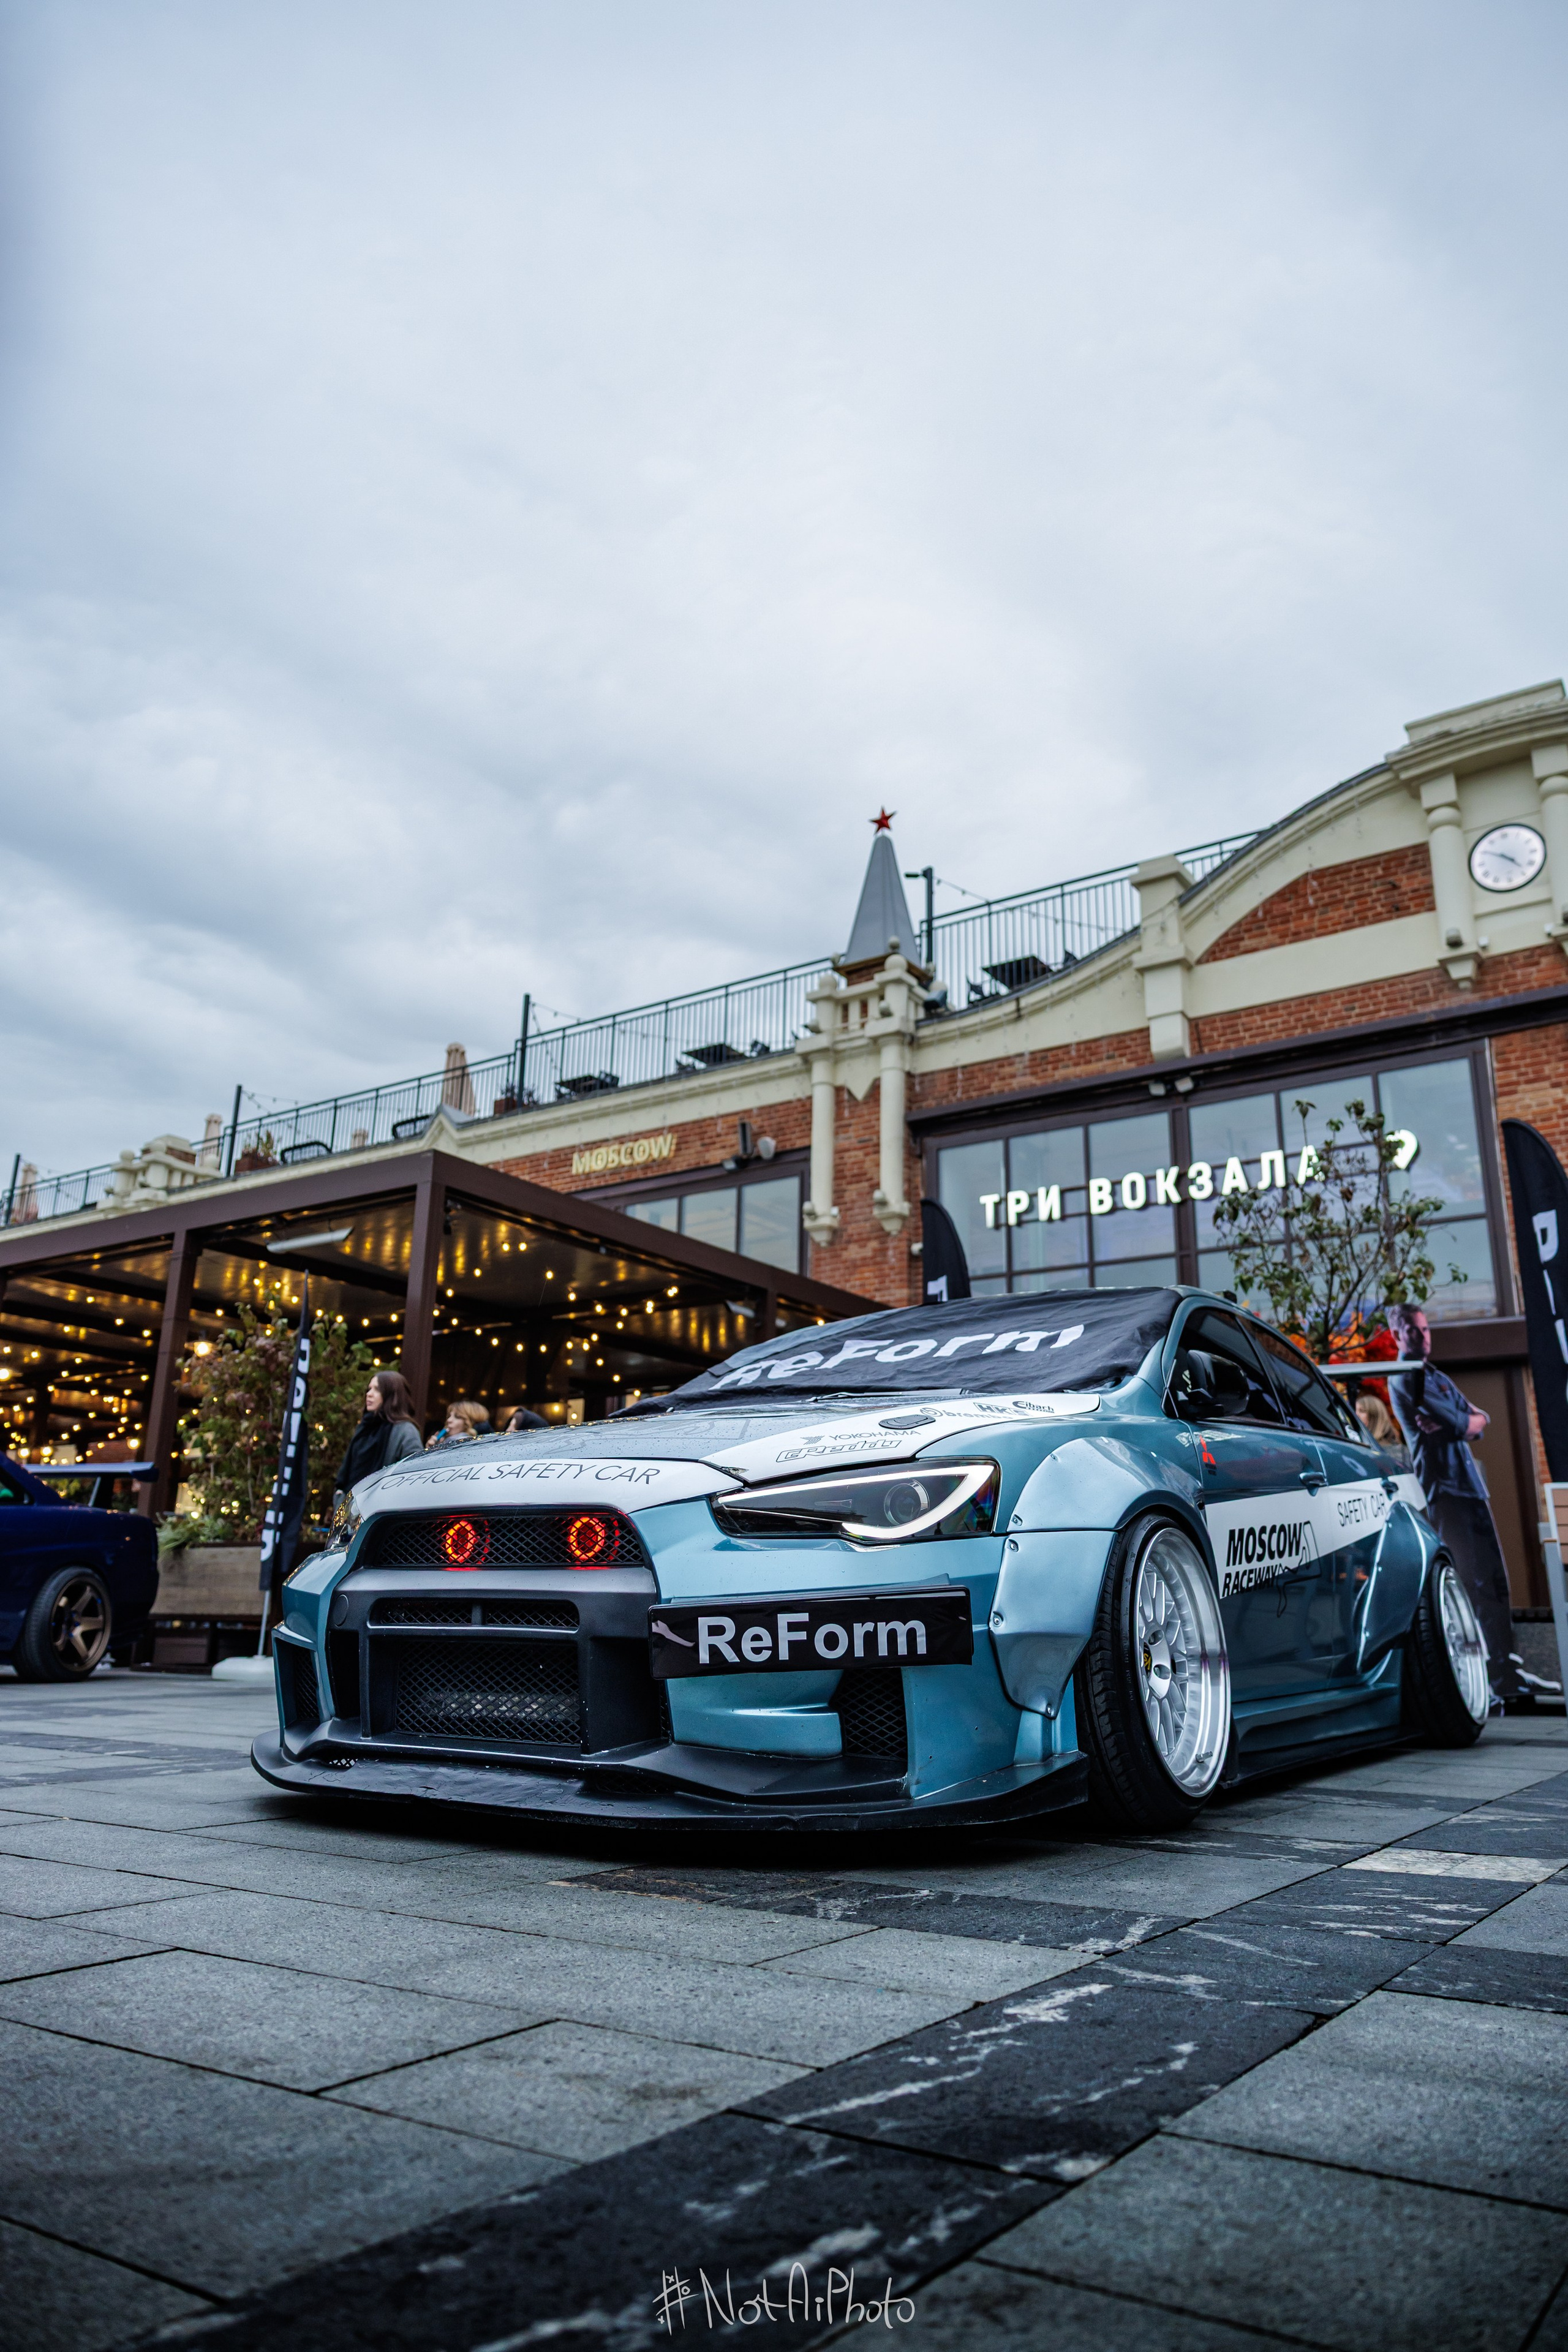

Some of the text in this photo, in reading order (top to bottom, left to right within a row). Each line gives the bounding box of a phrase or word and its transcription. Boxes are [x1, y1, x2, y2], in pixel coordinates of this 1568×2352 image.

[571, 1133, 675, 1175] MOSCOW
[979, 1184, 1061, 1228] ТРИ
[707, 1324, 1085, 1390] ReForm
[942, 1410, 1014, 1419] brembo
[975, 1403, 1031, 1416] HKS
[1012, 1401, 1054, 1412] Eibach
[829, 1430, 921, 1441] YOKOHAMA
[381, 1463, 661, 1490] OFFICIAL SAFETY CAR
[1337, 1493, 1387, 1527] SAFETY CAR
[1226, 1522, 1302, 1567] MOSCOW
[1222, 1564, 1279, 1597] RACEWAY
[698, 1613, 927, 1664] ReForm
